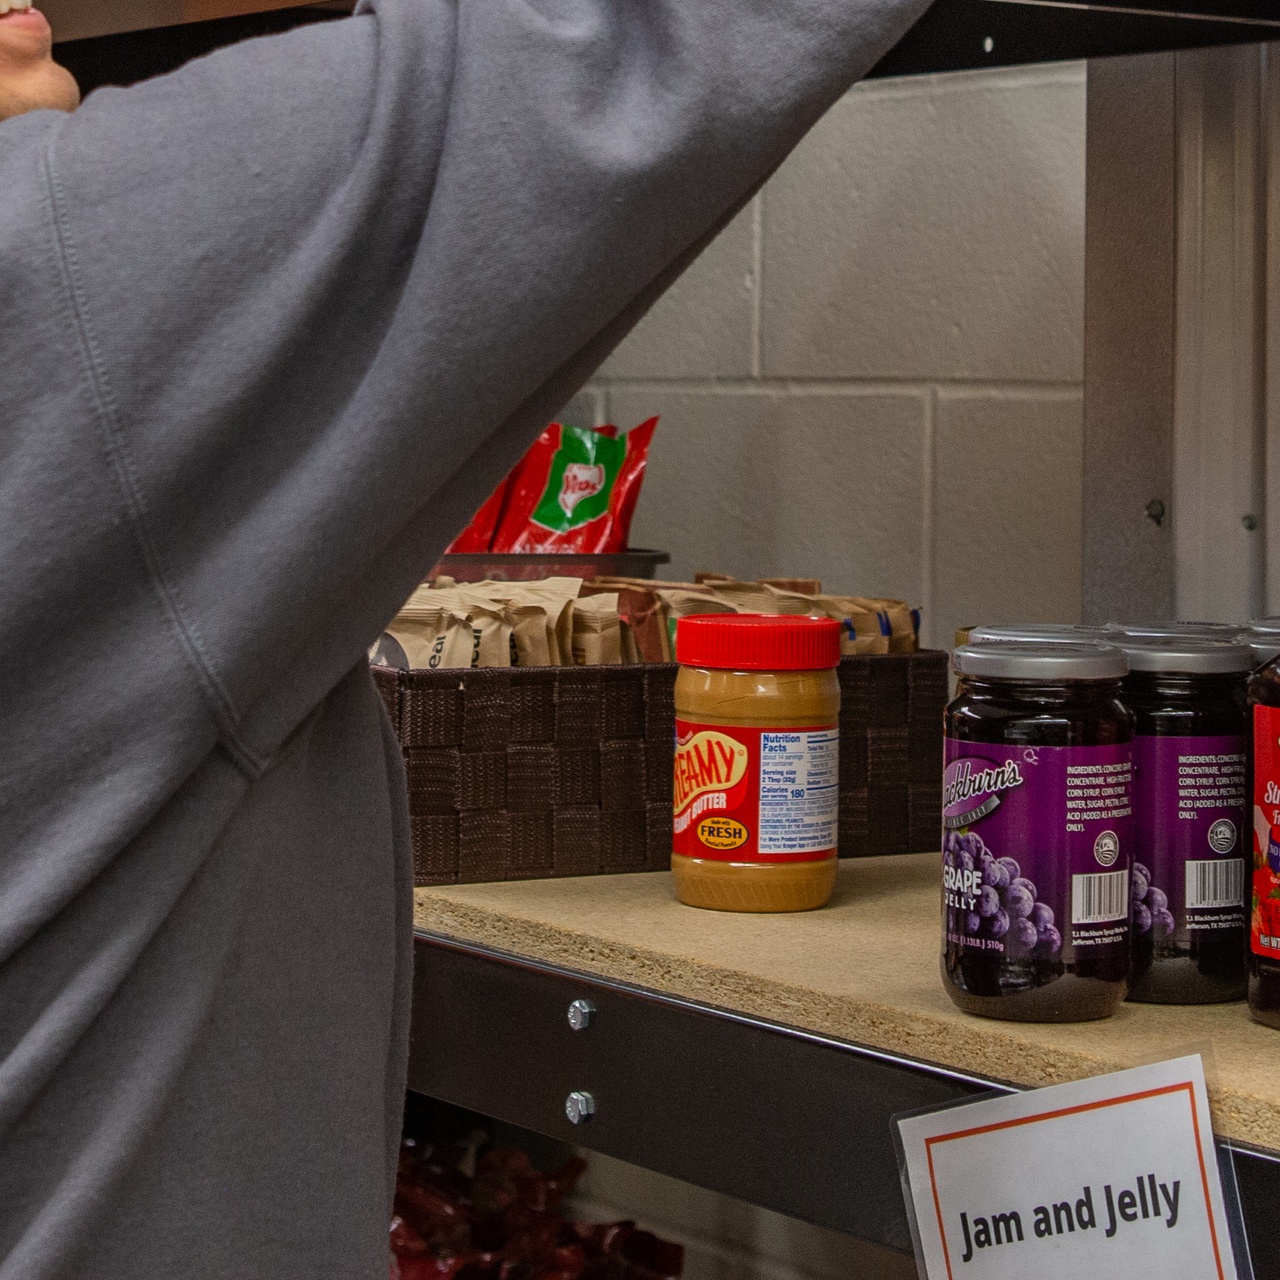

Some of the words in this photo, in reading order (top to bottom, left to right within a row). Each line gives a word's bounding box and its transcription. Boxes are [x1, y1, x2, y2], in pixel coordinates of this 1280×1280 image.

[763, 734, 800, 743] Nutrition
[763, 744, 787, 752] Facts
[944, 760, 1023, 809] ackburn's
[1179, 778, 1195, 786] CORN
[791, 789, 805, 799] 180
[692, 792, 727, 819] BUTTER
[701, 825, 742, 839] FRESH
[1270, 844, 1278, 856] NO
[943, 865, 982, 896] GRAPE
[945, 893, 977, 911] JELLY
[960, 1208, 1025, 1263] Jam
[1033, 1186, 1097, 1239] and
[1104, 1173, 1181, 1238] Jelly
